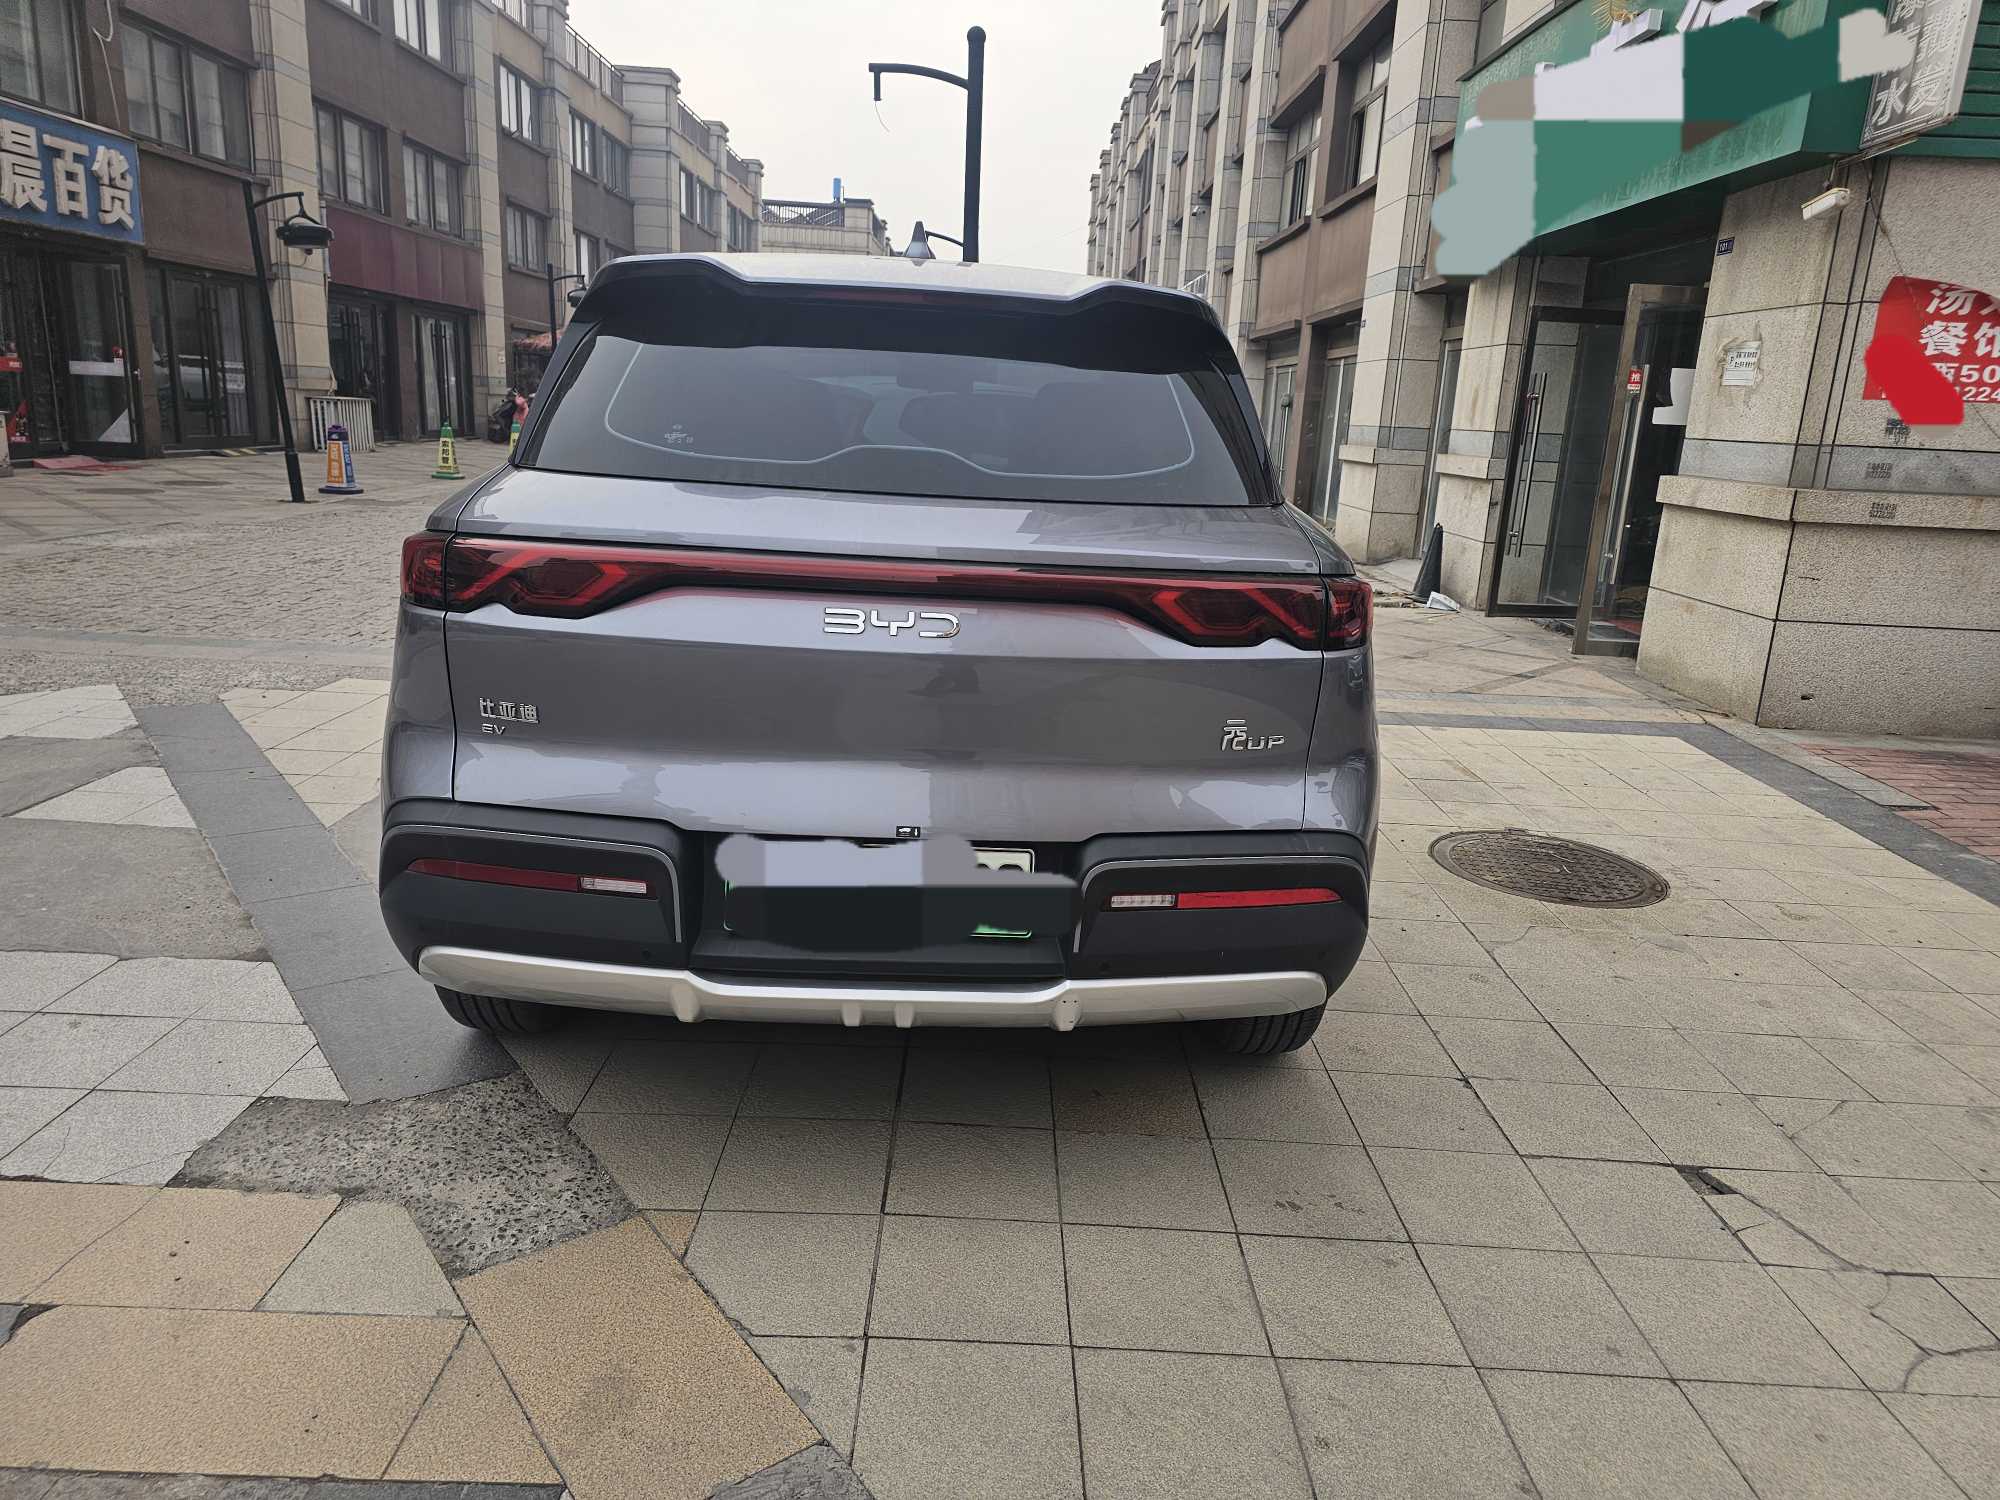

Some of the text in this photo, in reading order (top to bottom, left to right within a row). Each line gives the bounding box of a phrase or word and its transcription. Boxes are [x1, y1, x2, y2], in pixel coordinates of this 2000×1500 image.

[0, 118, 135, 230] 晨百货
[824, 607, 961, 638] BYD
[479, 697, 539, 723] 比亚迪
[482, 723, 506, 735] EV
